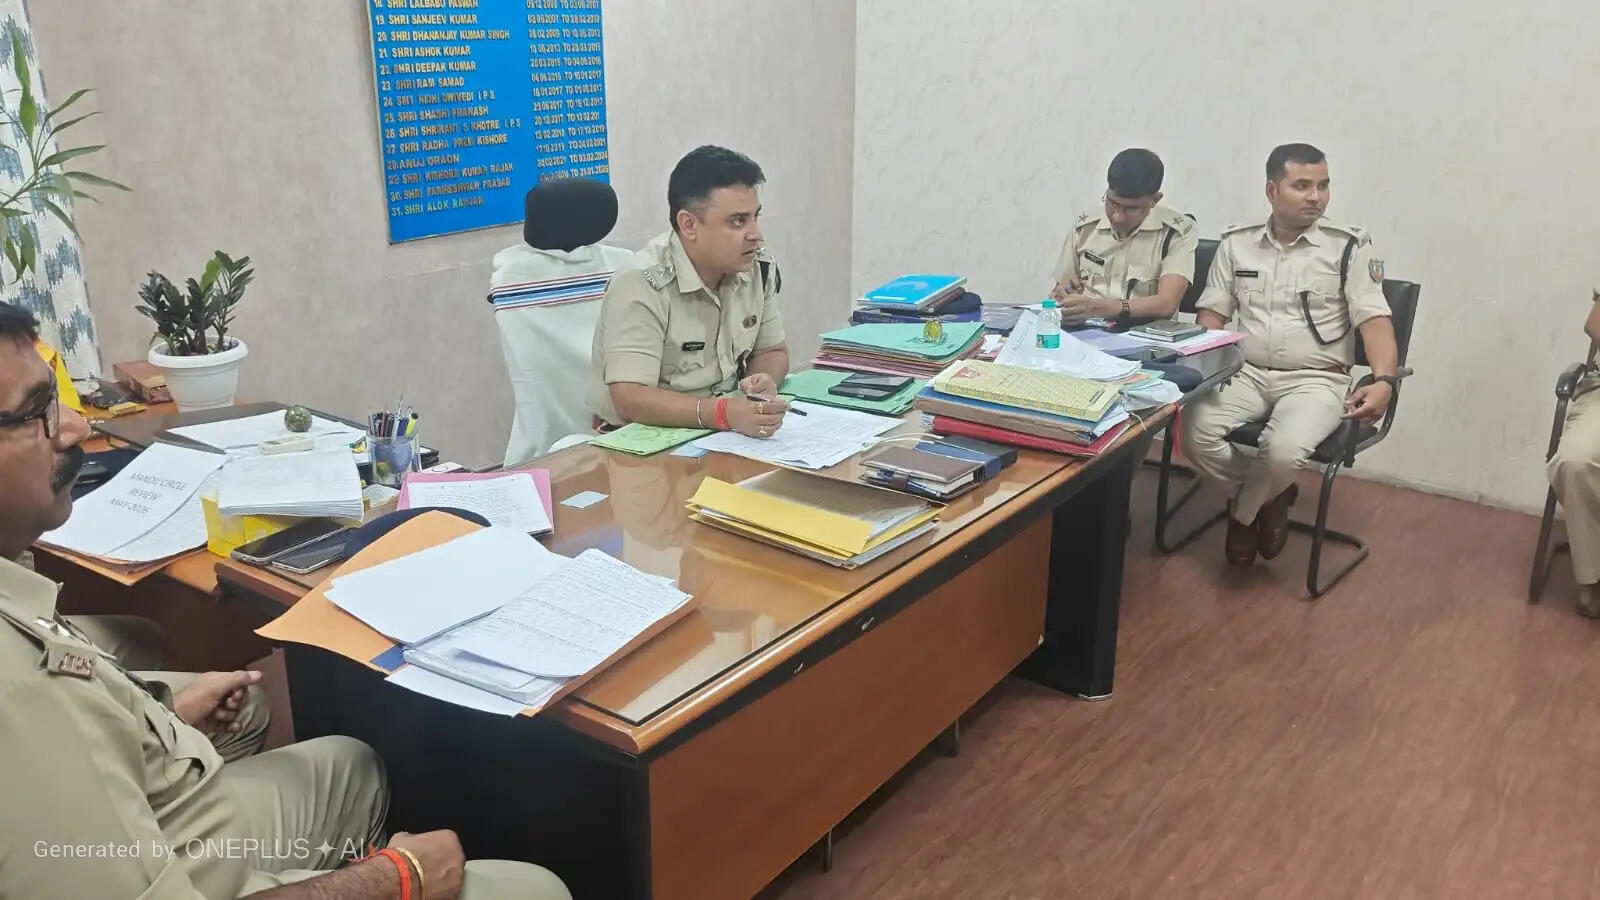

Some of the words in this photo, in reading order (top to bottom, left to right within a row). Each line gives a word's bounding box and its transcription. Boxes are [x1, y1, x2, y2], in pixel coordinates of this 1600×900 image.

[388, 14, 409, 25] SHRI
[411, 14, 446, 25] SANJEEV
[449, 14, 477, 24] KUMAR
[390, 30, 410, 41] SHRI
[412, 30, 457, 41] DHANANJAY
[459, 29, 486, 40] KUMAR
[488, 30, 510, 39] SINGH
[391, 47, 413, 58] SHRI
[414, 46, 442, 57] ASHOK
[443, 45, 471, 57] KUMAR
[393, 63, 414, 74] SHRI
[415, 62, 446, 73] DEEPAK
[448, 61, 476, 72] KUMAR
[395, 79, 415, 91] SHRI
[416, 78, 435, 89] RAM
[437, 76, 465, 88] SAMAD
[397, 111, 417, 122] SHRI
[398, 127, 418, 139] SHRI
[399, 141, 419, 154] SHRI
[403, 188, 423, 200] SHRI
[404, 203, 424, 216] SHRI
[427, 199, 449, 213] ALOK
